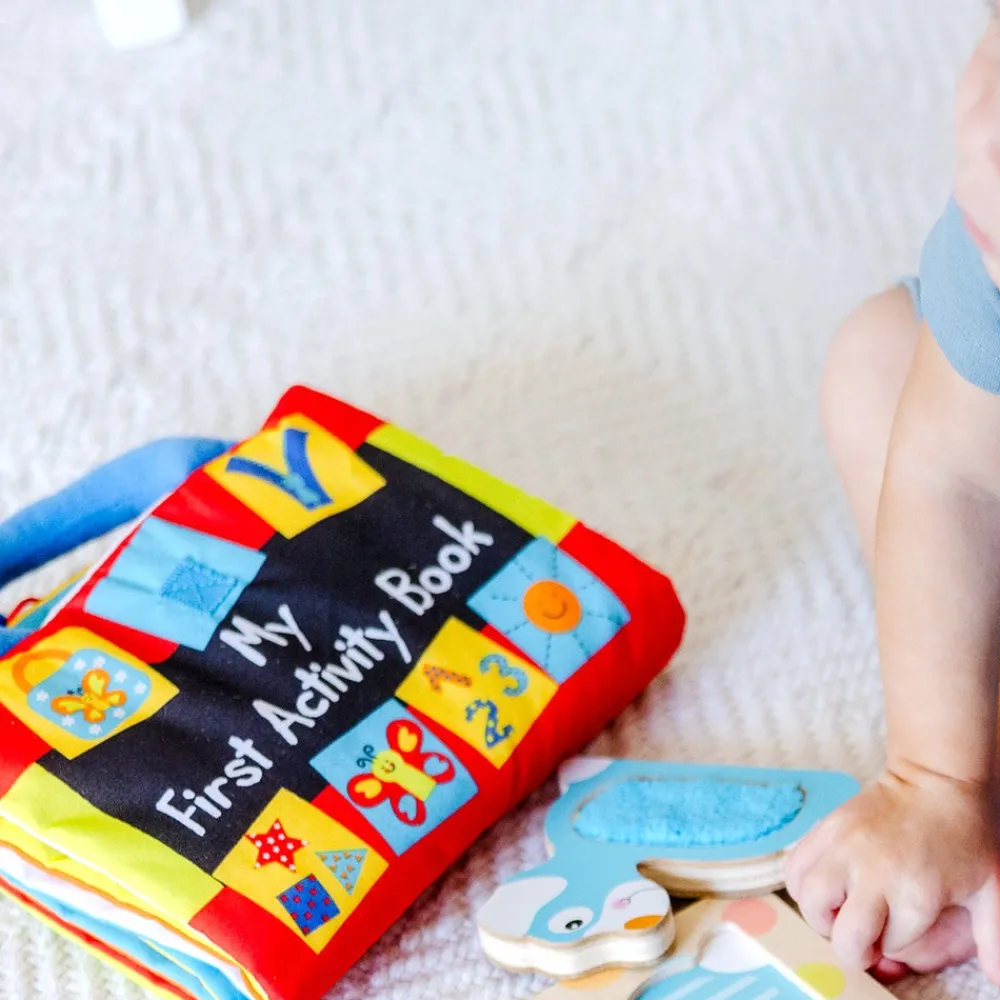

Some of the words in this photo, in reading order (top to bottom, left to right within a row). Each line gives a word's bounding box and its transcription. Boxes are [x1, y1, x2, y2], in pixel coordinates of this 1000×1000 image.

[219, 604, 312, 667] My
[155, 735, 274, 837] First
[252, 610, 412, 746] Activity
[374, 514, 494, 616] Book
[479, 654, 529, 697] 3
[465, 699, 514, 748] 2
